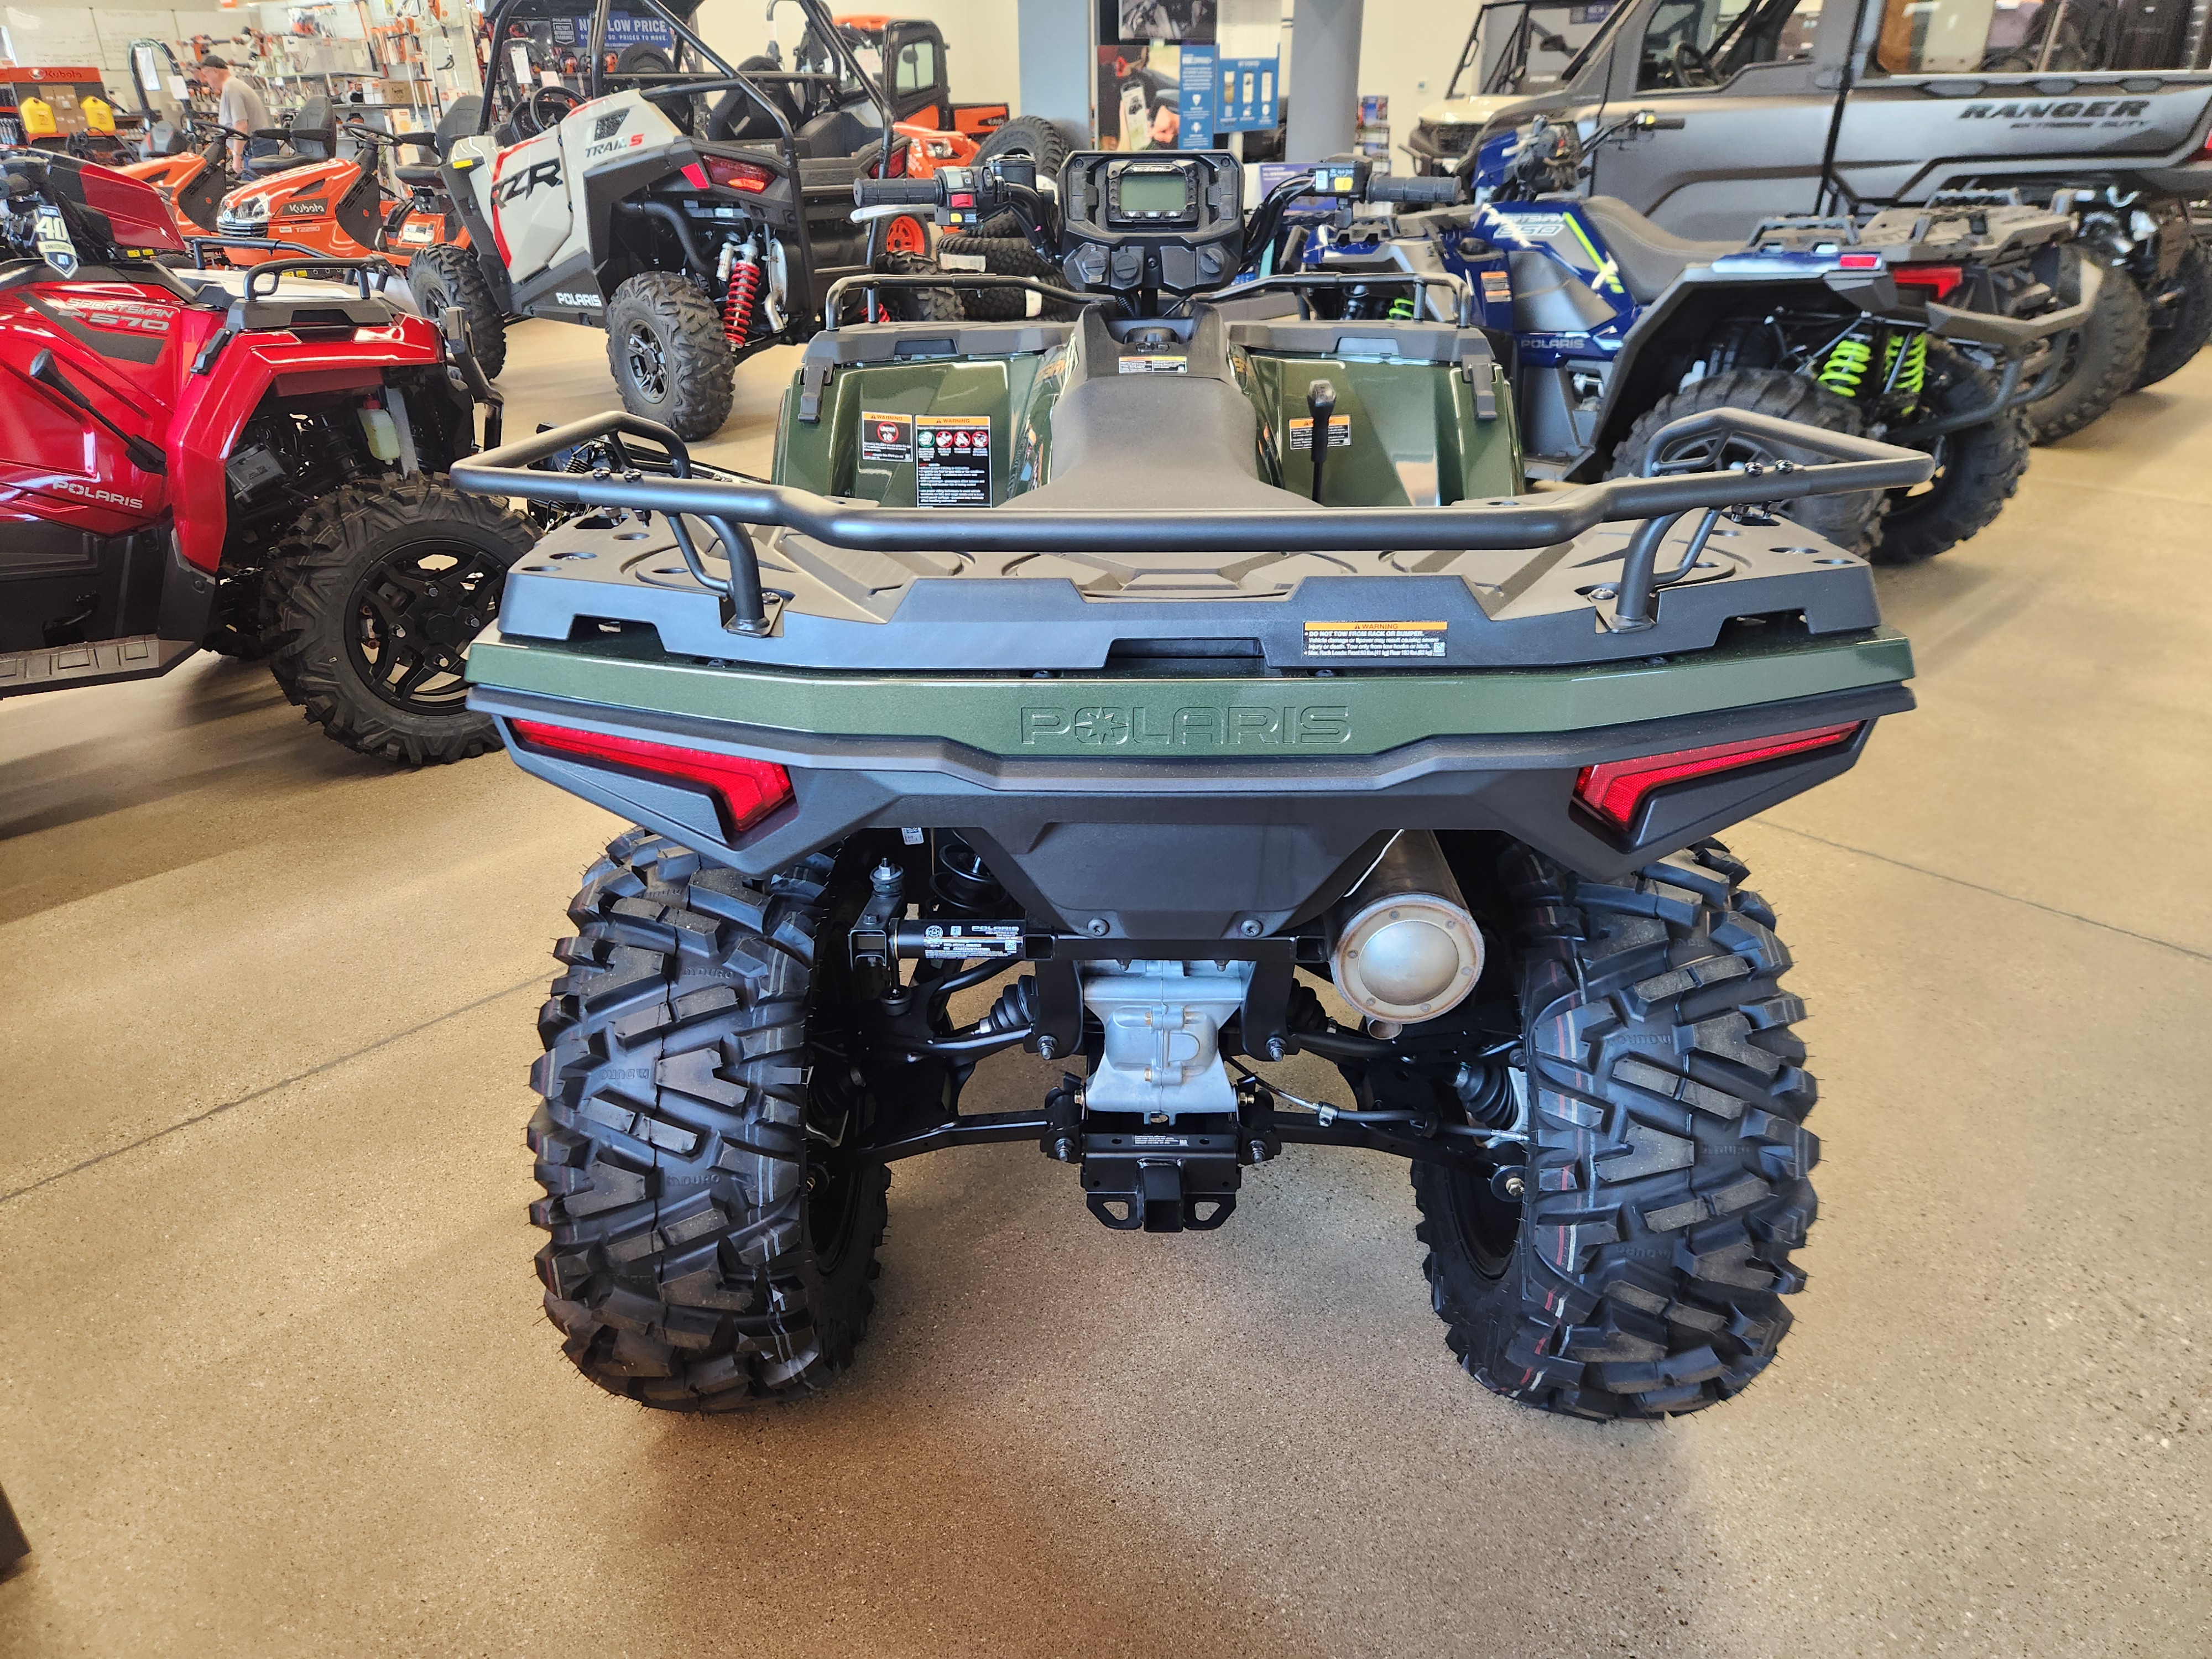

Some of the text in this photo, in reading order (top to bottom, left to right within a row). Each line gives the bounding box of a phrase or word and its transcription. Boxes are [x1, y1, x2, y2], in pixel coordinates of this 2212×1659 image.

[608, 19, 667, 33] LOW PRICE
[45, 70, 82, 79] Kubota
[1958, 100, 2150, 119] RANGER
[585, 133, 645, 158] TRAIL S
[288, 202, 325, 213] Kubota
[35, 216, 68, 241] 40
[555, 291, 603, 307] POLARIS
[66, 298, 174, 319] SPORTSMAN
[88, 313, 170, 331] 570
[1520, 338, 1585, 349] POLARIS
[53, 478, 143, 509] POLARIS
[1020, 706, 1350, 744] POLARIS
